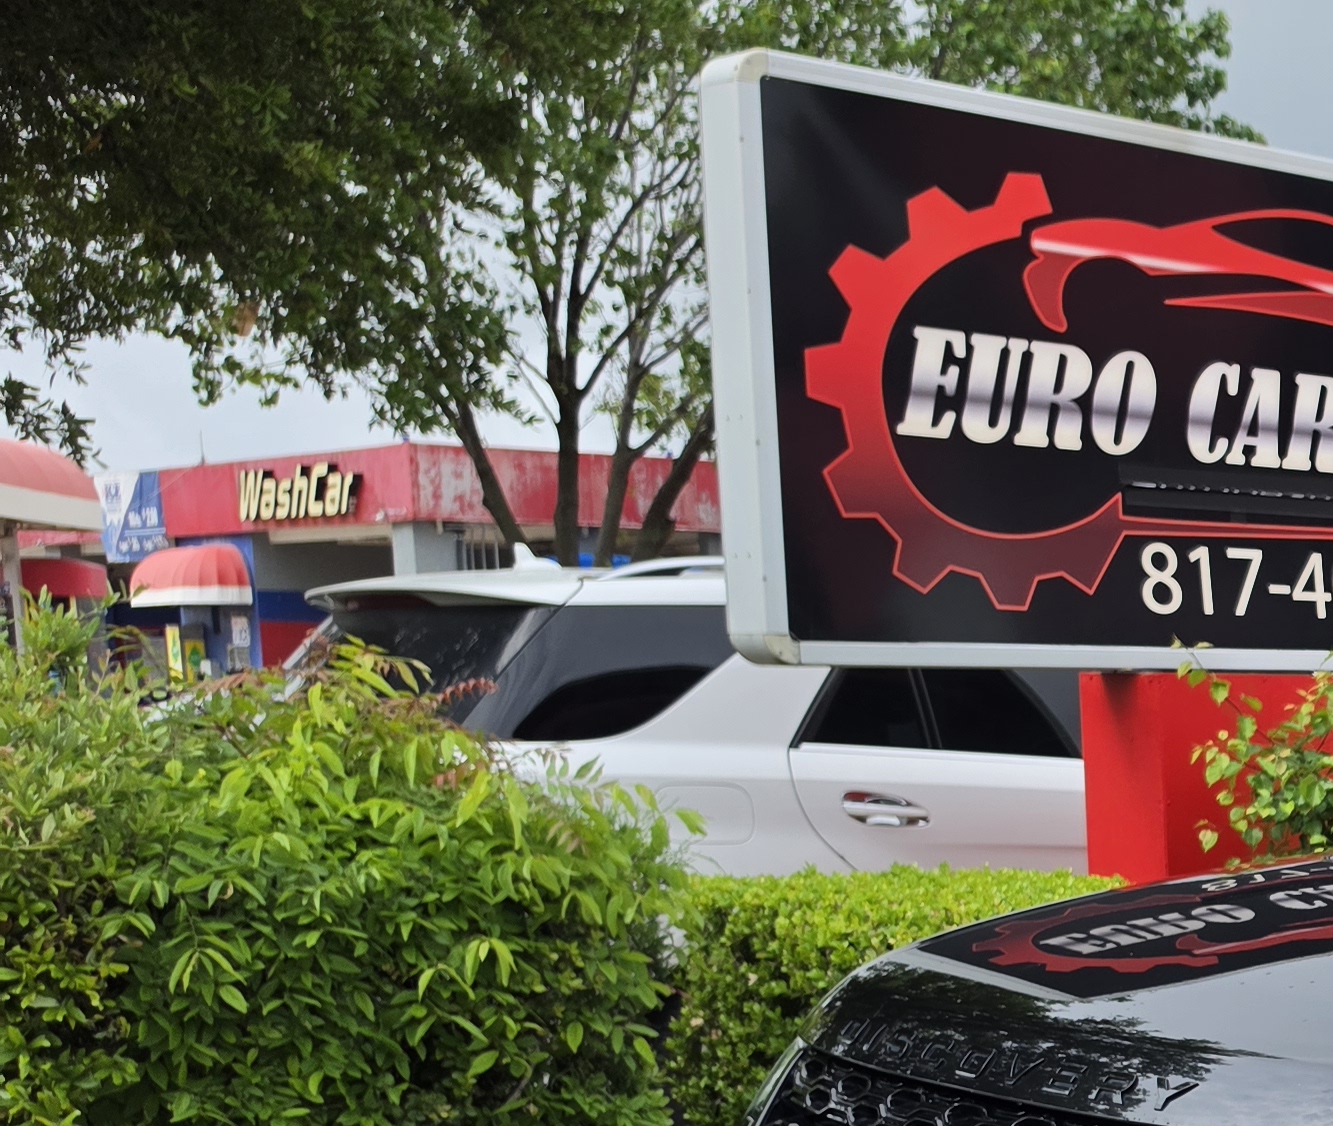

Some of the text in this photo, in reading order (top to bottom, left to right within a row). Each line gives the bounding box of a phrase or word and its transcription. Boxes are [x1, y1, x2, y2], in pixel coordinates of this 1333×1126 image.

[896, 325, 1157, 456] EURO
[239, 461, 354, 522] WashCar
[841, 1017, 1200, 1112] DISCOVERY
